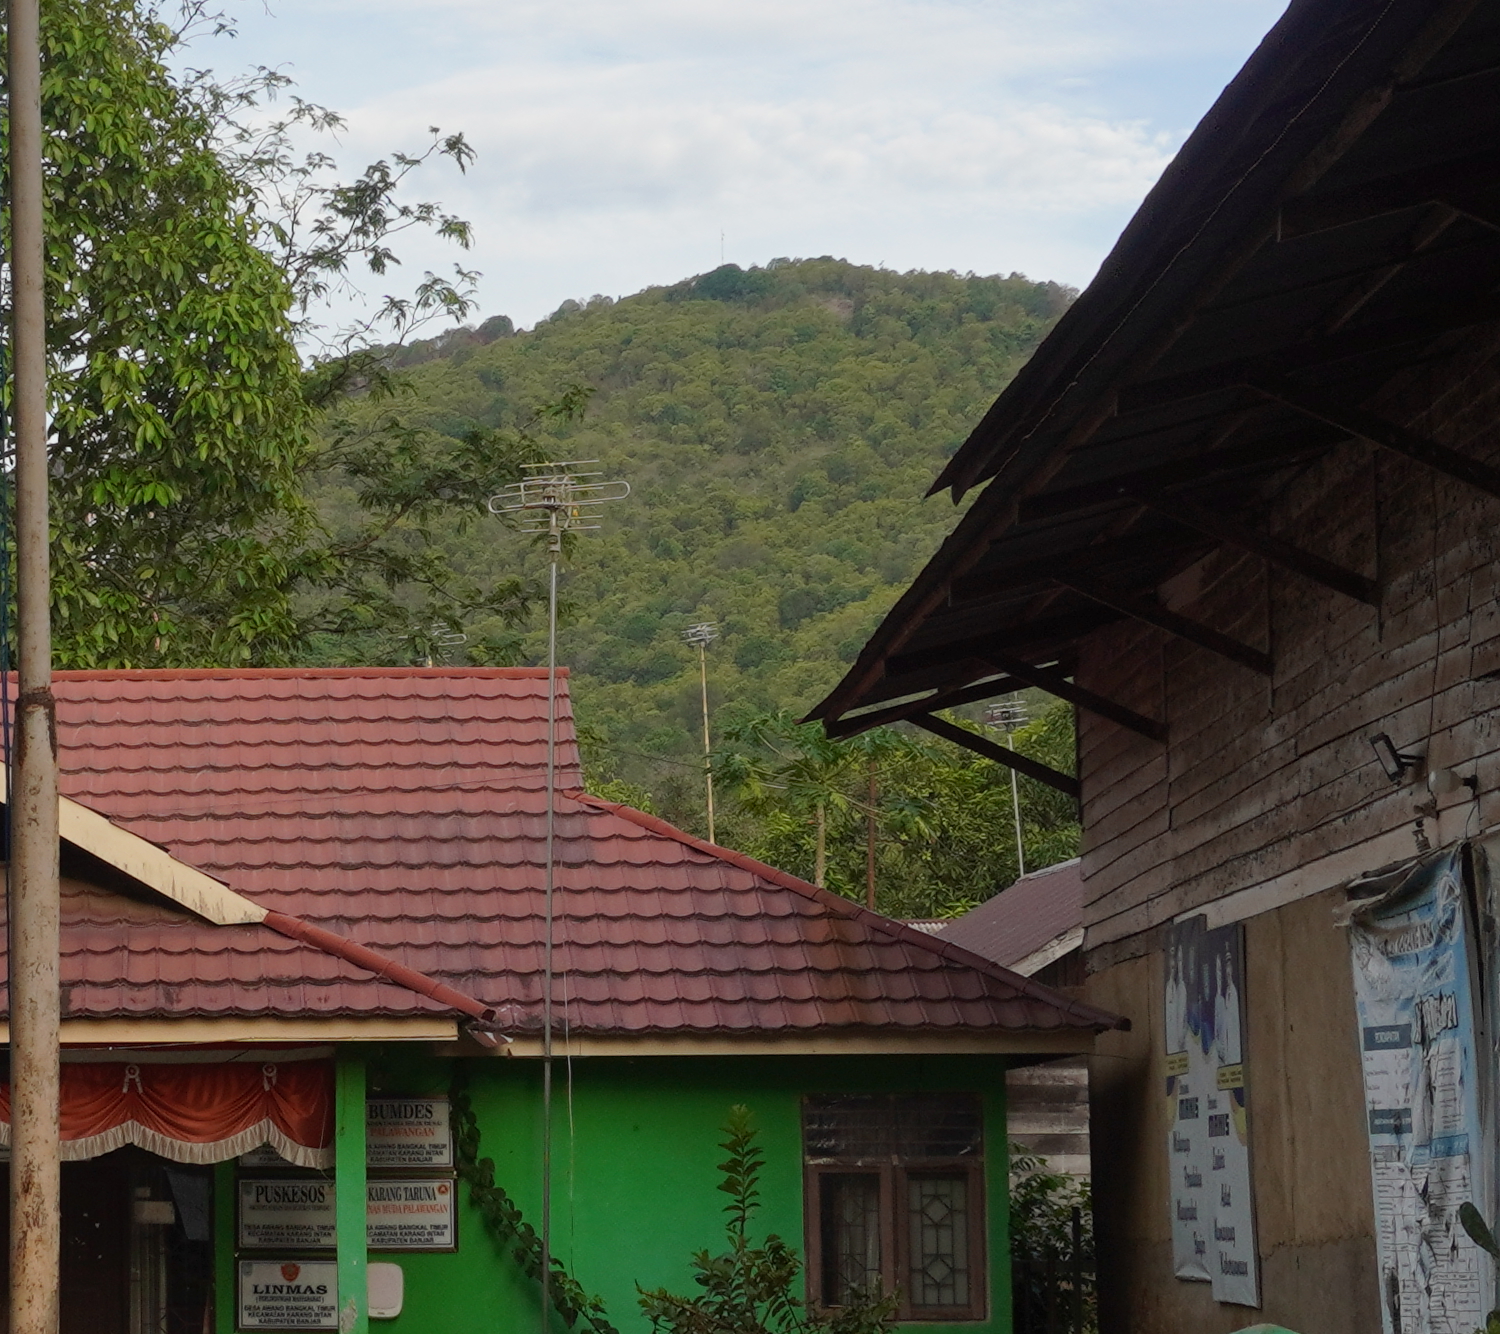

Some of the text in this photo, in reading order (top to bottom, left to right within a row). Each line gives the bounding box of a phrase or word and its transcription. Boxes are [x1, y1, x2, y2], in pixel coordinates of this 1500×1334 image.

[368, 1104, 433, 1119] BUMDES
[256, 1185, 325, 1203] PUSKESOS
[368, 1187, 436, 1201] KARANG TARUNA
[253, 1285, 328, 1295] LINMAS
